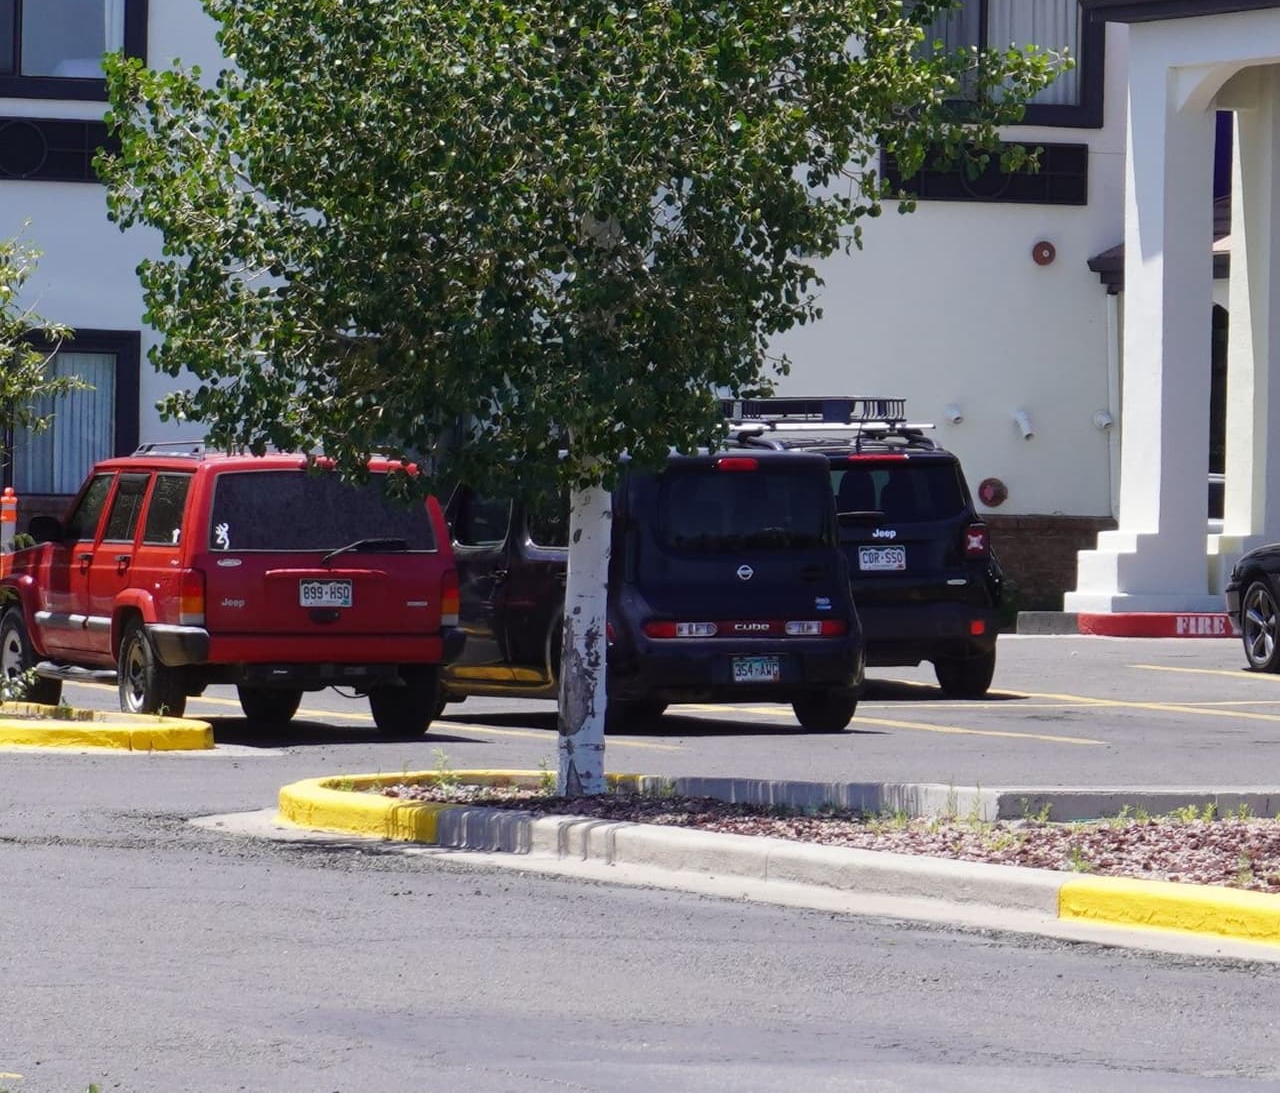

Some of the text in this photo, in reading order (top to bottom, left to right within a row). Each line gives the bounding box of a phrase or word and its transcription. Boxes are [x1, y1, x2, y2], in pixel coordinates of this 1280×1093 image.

[872, 528, 897, 540] Jeep
[221, 597, 246, 608] Jeep
[734, 623, 770, 631] cube
[1176, 616, 1226, 635] FIRE
